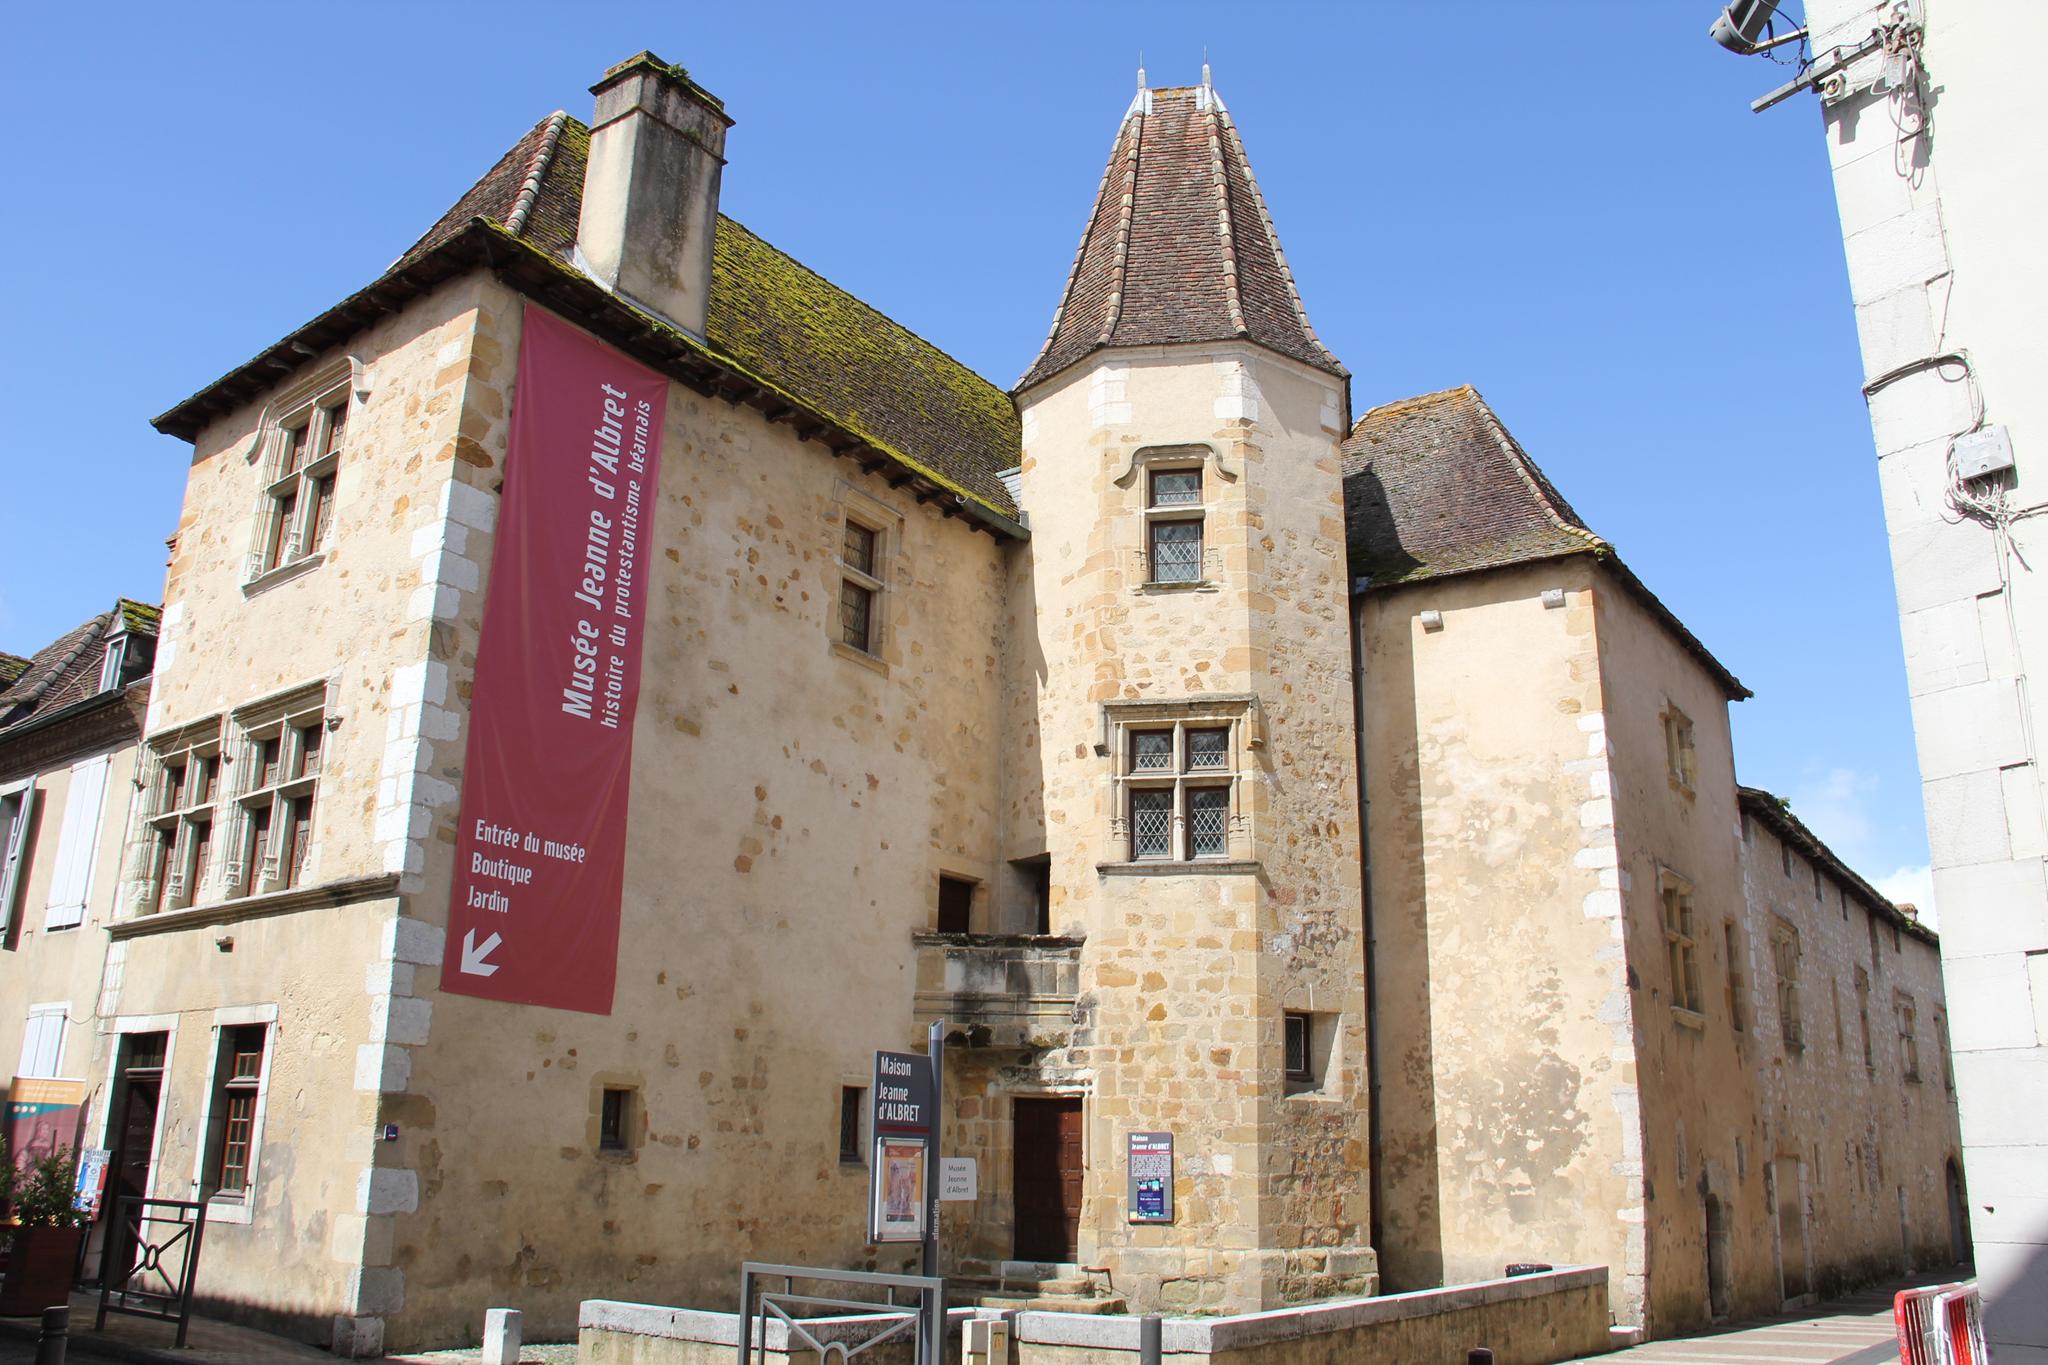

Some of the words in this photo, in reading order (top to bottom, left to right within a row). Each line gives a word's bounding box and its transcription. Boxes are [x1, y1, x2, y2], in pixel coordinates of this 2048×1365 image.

[588, 383, 628, 500] d'Albret
[627, 399, 651, 474] béarnais
[574, 510, 613, 610] Jeanne
[614, 479, 641, 618] protestantisme
[611, 625, 627, 647] du
[562, 619, 600, 720] Musée
[600, 654, 626, 729] histoire
[475, 819, 520, 849] Entrée
[524, 832, 540, 854] du
[544, 839, 586, 864] musée
[471, 852, 533, 886] Boutique
[467, 885, 509, 913] Jardin
[880, 1056, 912, 1077] Maison
[878, 1082, 909, 1103] Jeanne
[878, 1103, 920, 1123] d'ALBRET
[947, 1175, 968, 1183] Jeanne
[948, 1164, 967, 1173] Musée
[946, 1186, 969, 1195] d'Albret
